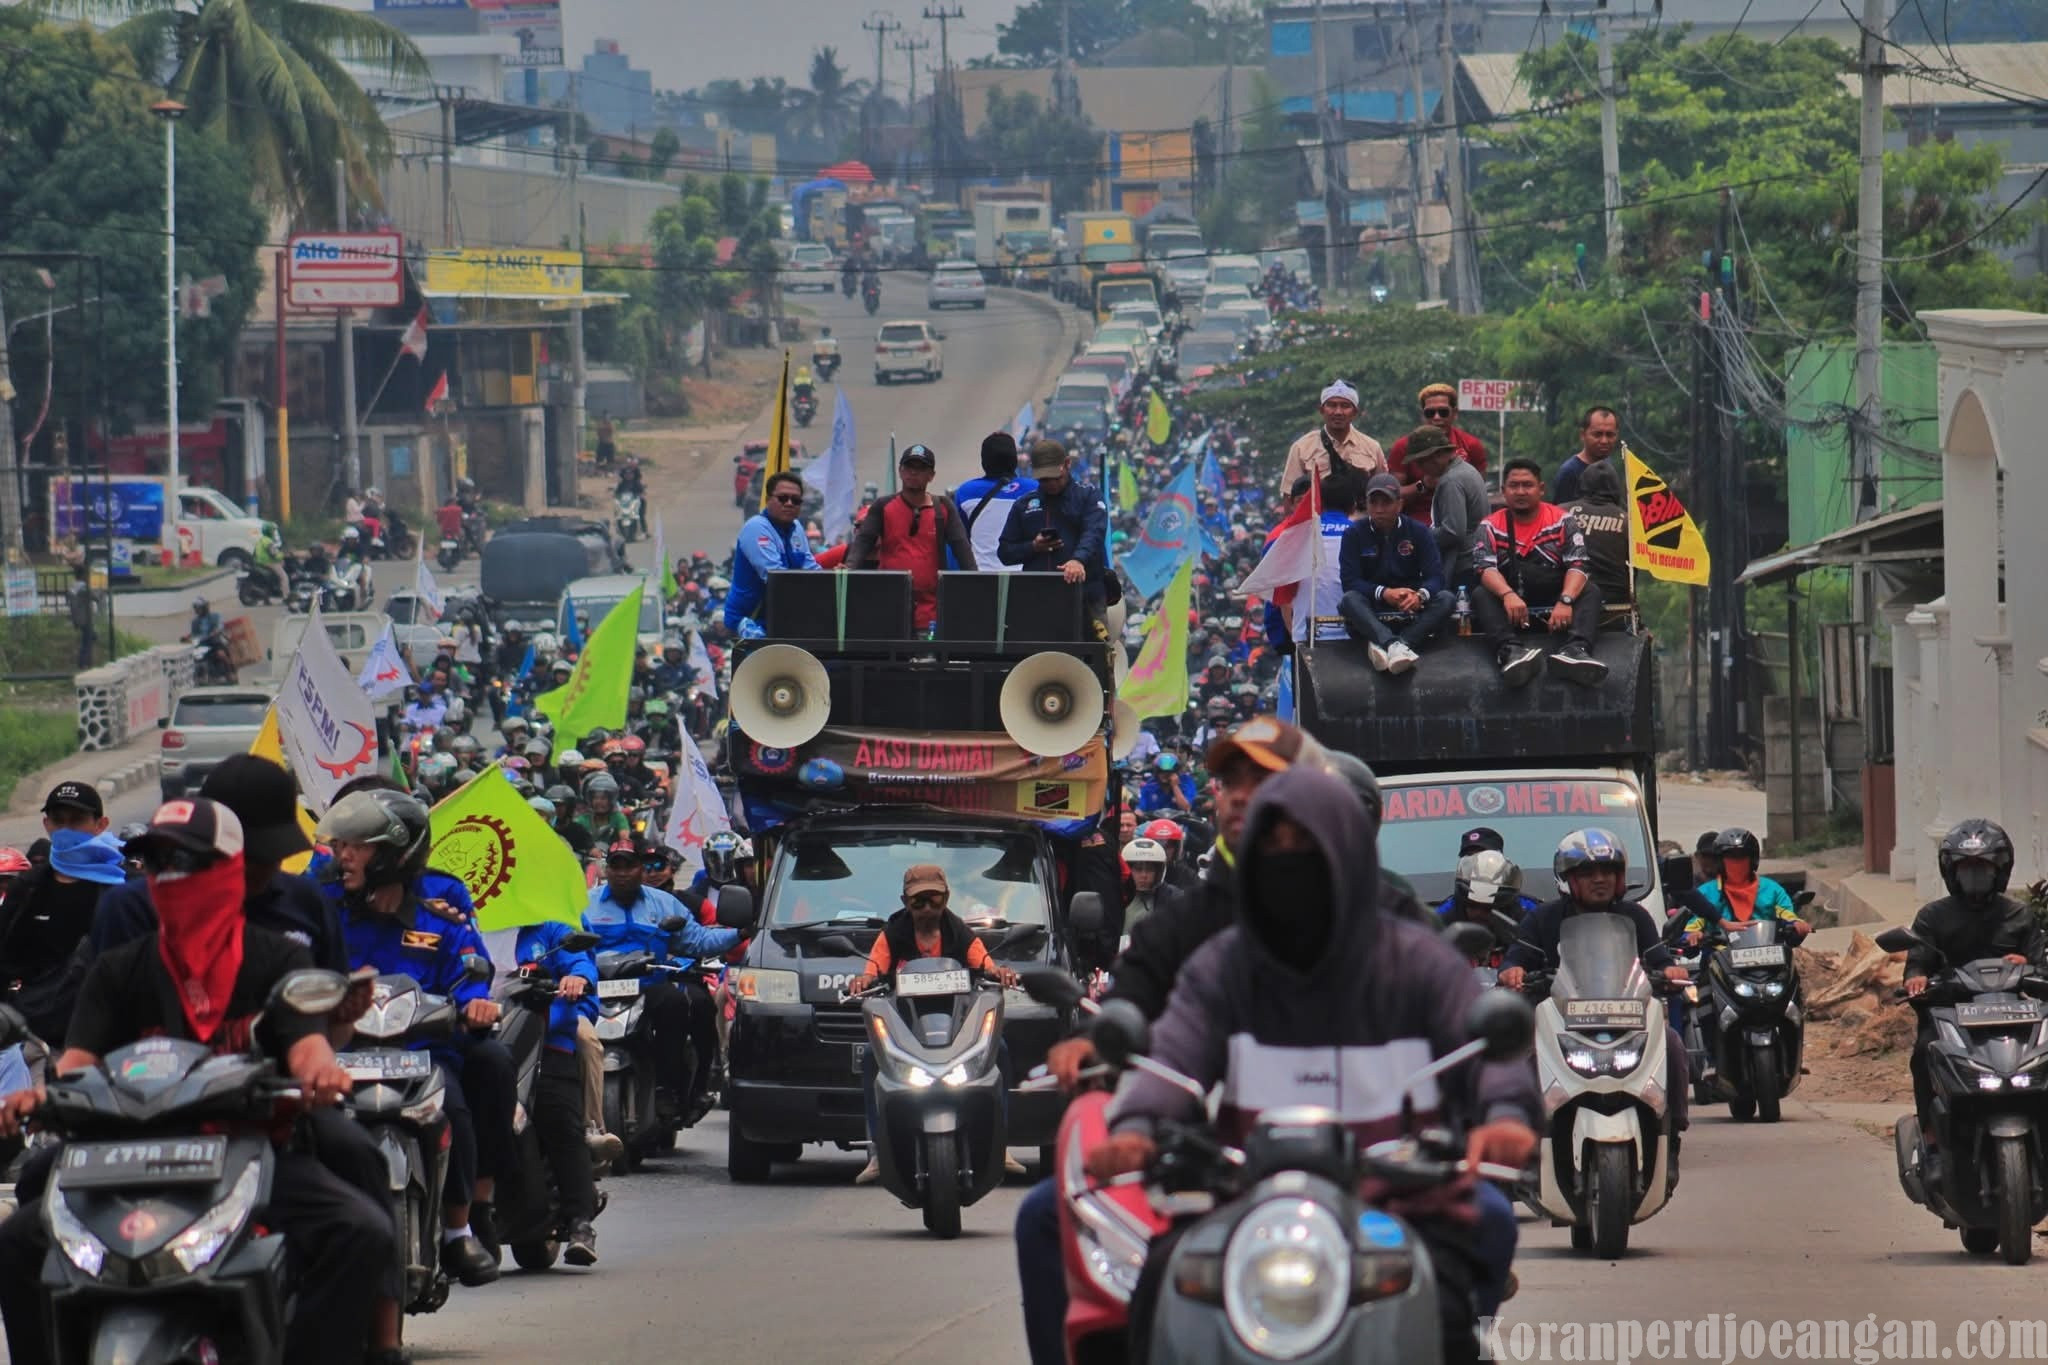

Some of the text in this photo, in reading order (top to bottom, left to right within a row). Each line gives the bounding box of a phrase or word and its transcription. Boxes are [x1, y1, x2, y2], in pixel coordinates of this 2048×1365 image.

[299, 663, 340, 751] FSPMI
[854, 740, 995, 771] AKSI DAMAI
[1381, 783, 1609, 821] ARDA METAL
